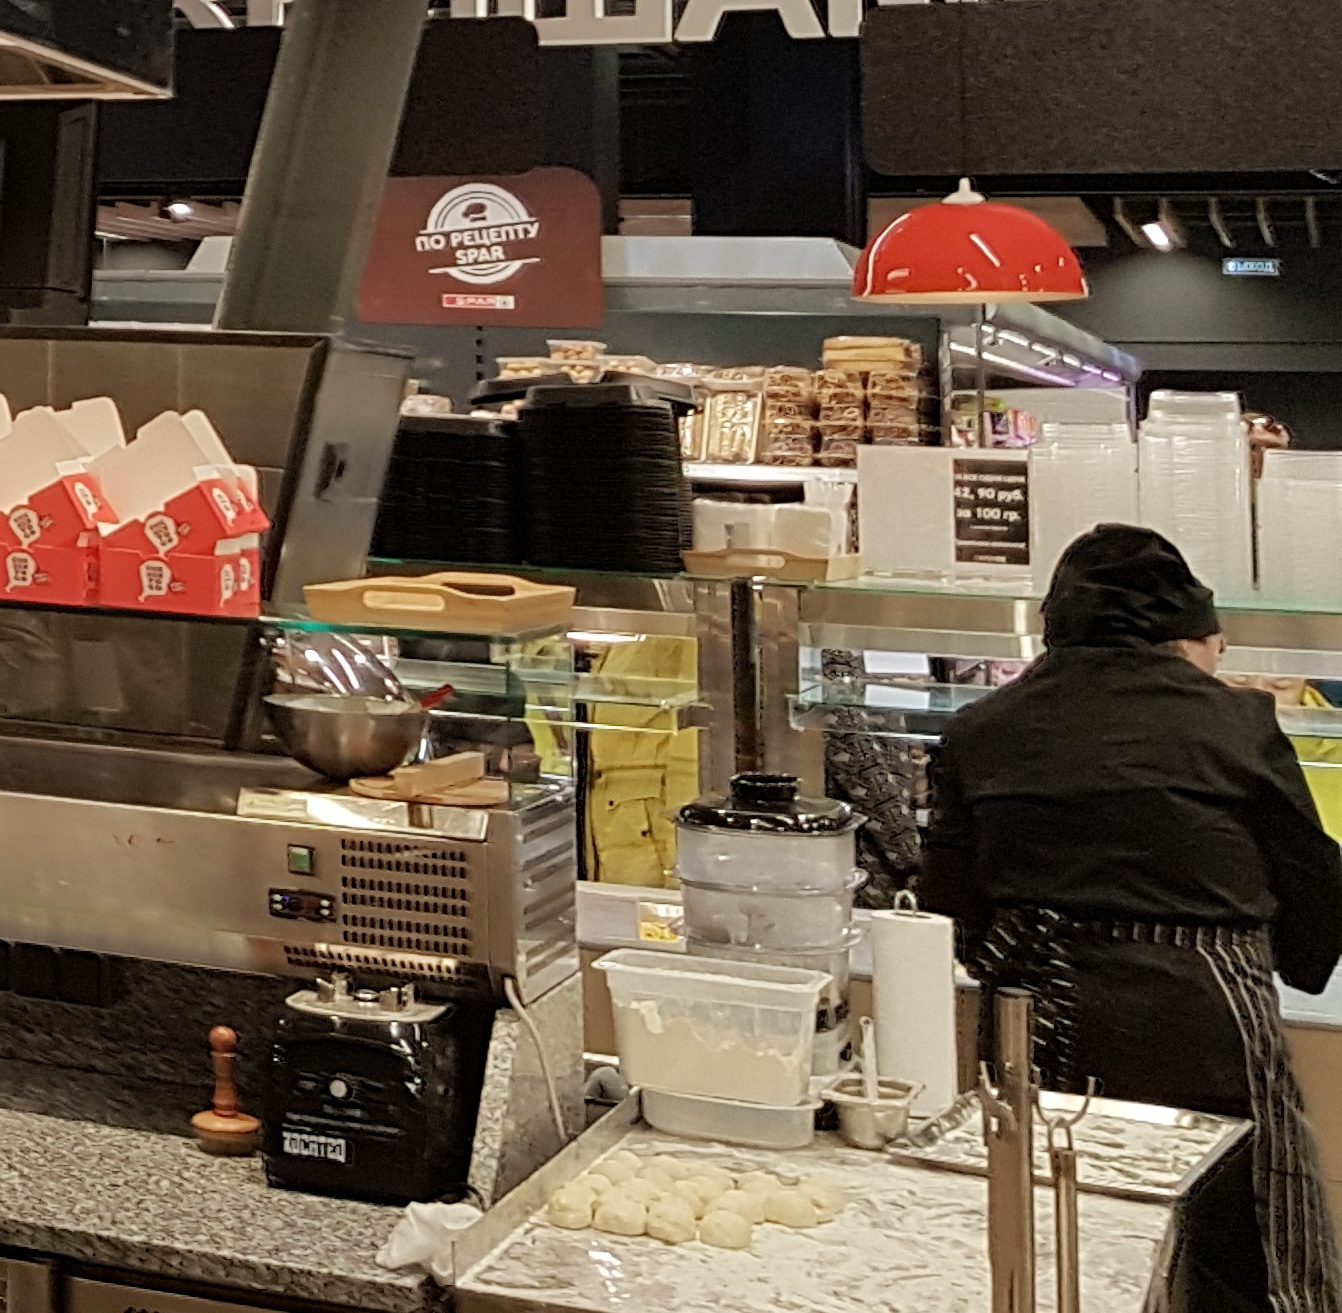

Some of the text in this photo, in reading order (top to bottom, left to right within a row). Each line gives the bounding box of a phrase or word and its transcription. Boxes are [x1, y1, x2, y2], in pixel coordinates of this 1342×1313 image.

[414, 221, 540, 252] ПО РЕЦЕПТУ
[455, 245, 505, 265] SPAR
[976, 507, 1001, 520] 100
